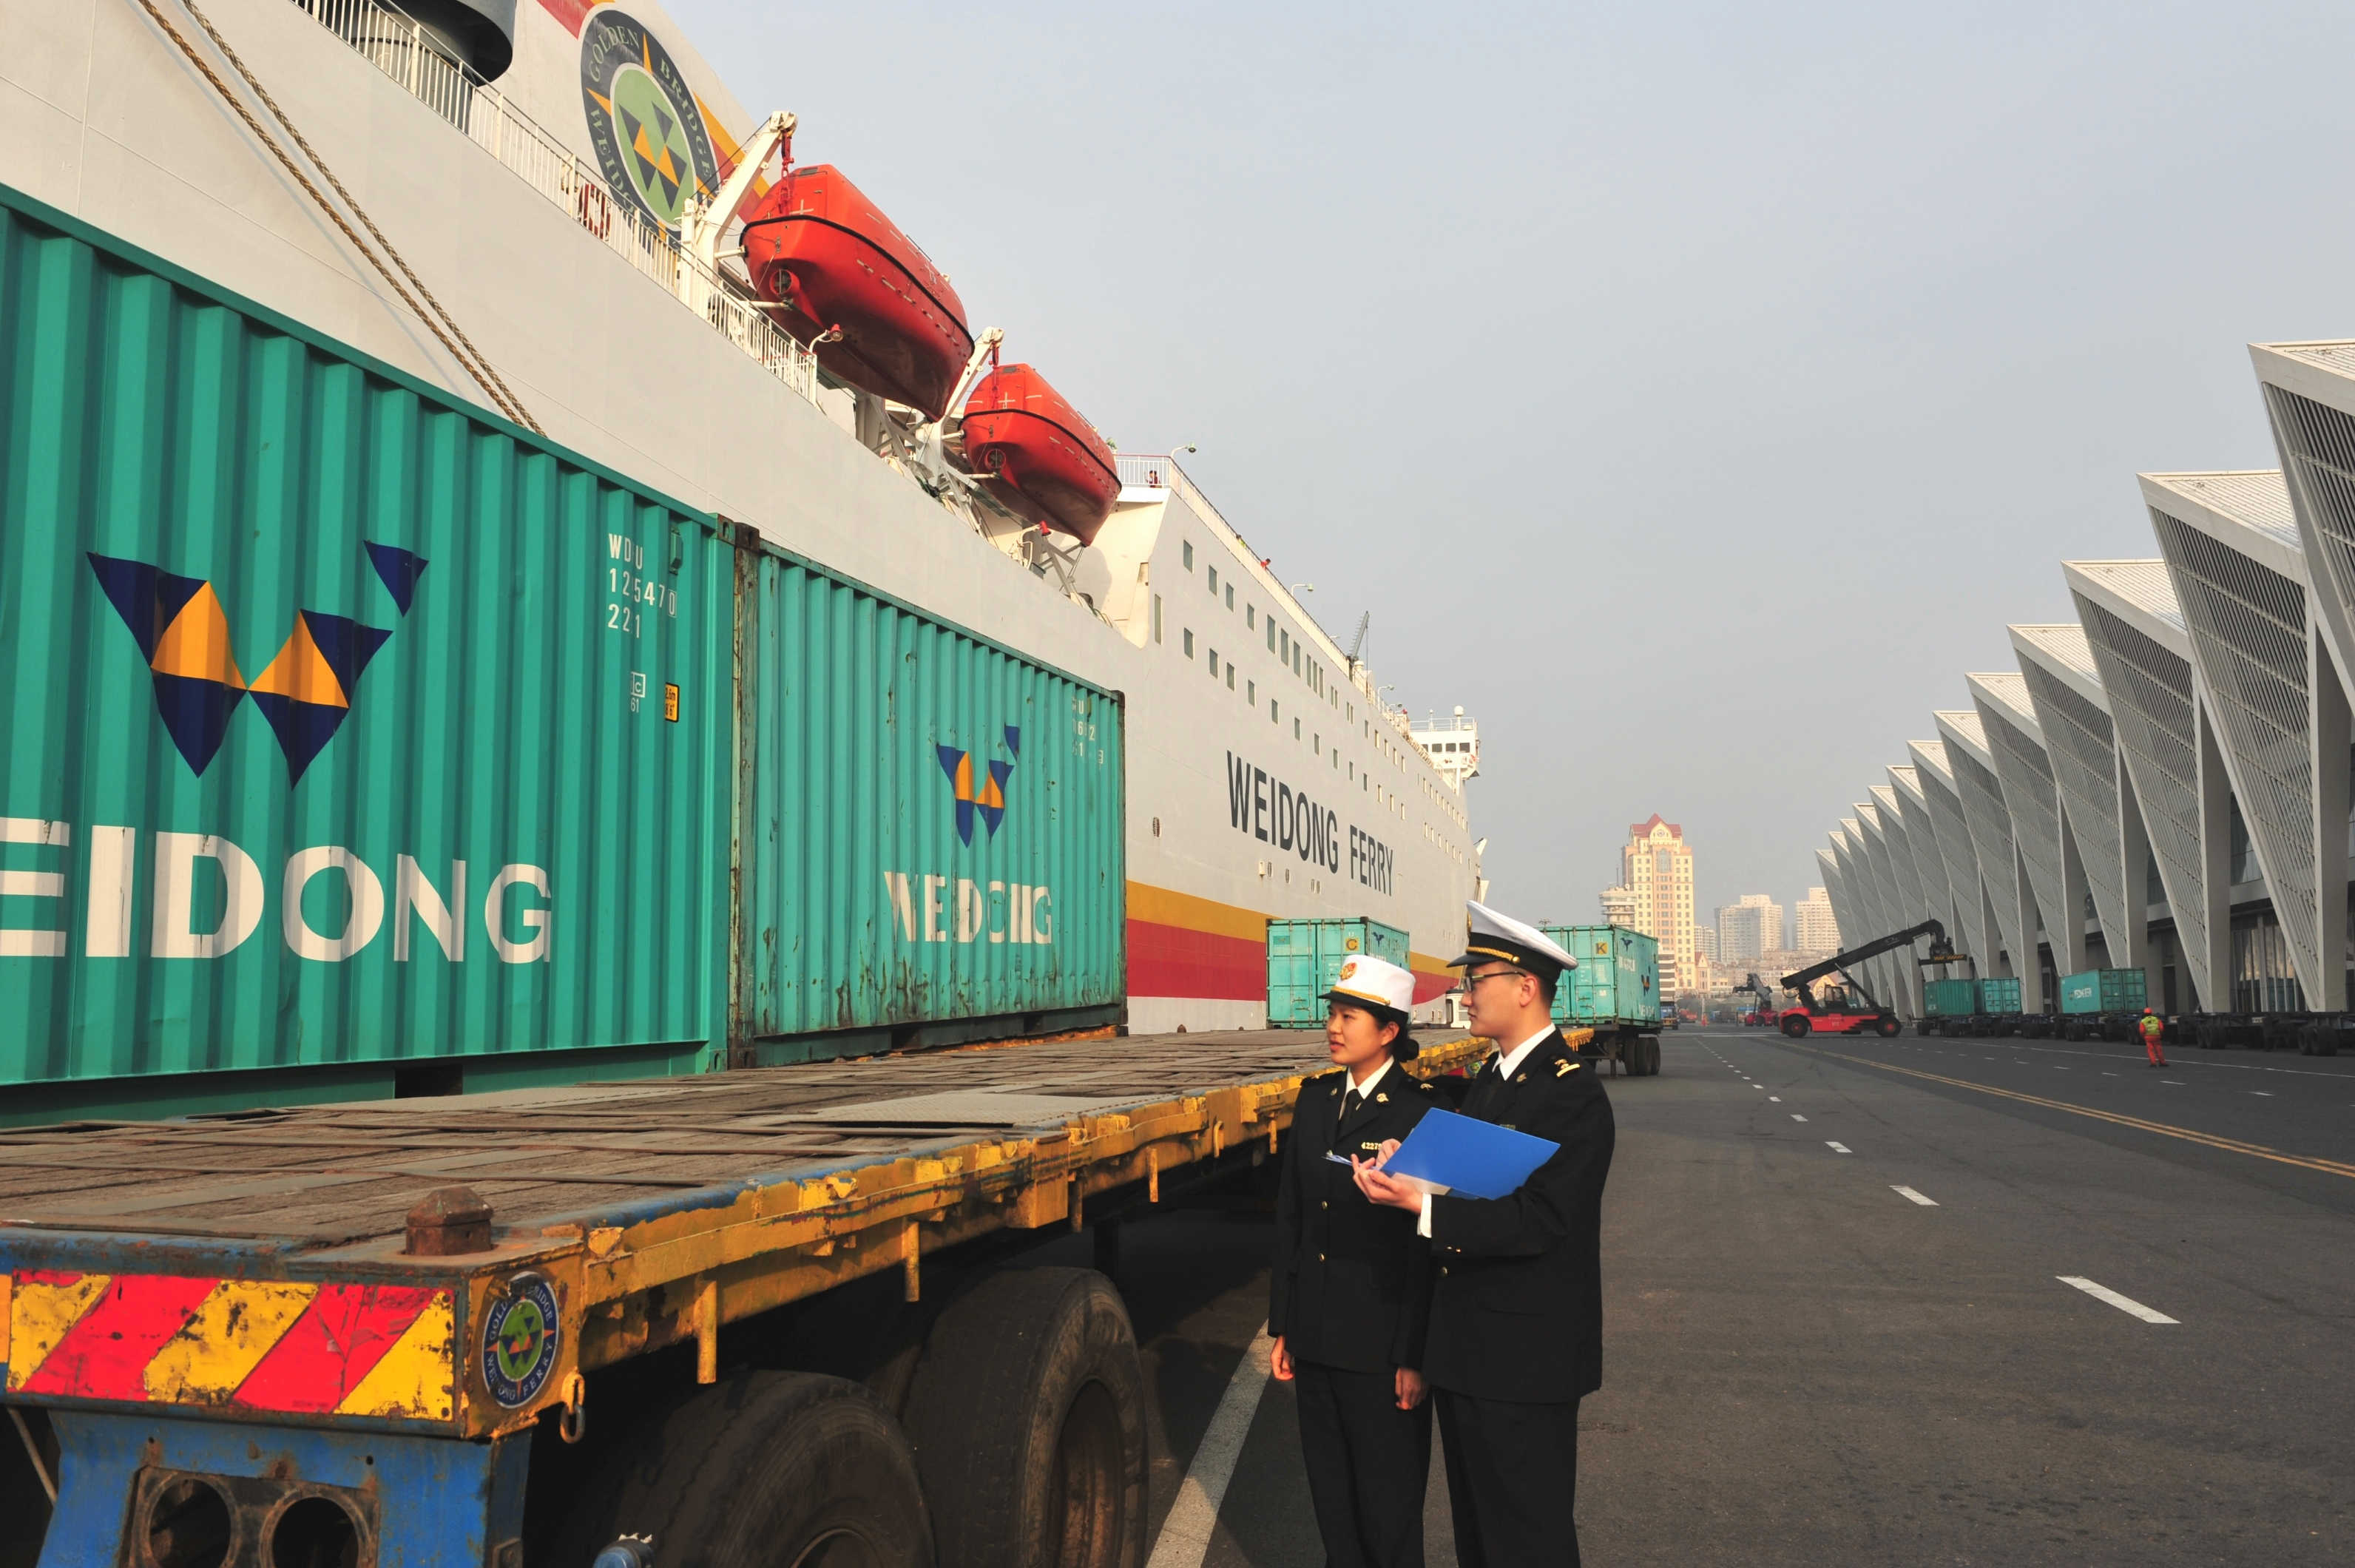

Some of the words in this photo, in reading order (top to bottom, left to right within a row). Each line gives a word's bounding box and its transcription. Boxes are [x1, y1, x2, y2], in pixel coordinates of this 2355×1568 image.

[588, 25, 640, 83] GOLDEN
[660, 58, 712, 178] BRIDGE
[1226, 750, 1339, 874] WEIDONG
[1350, 824, 1393, 896] FERRY
[1345, 939, 1358, 951] C
[1596, 942, 1607, 955] K
